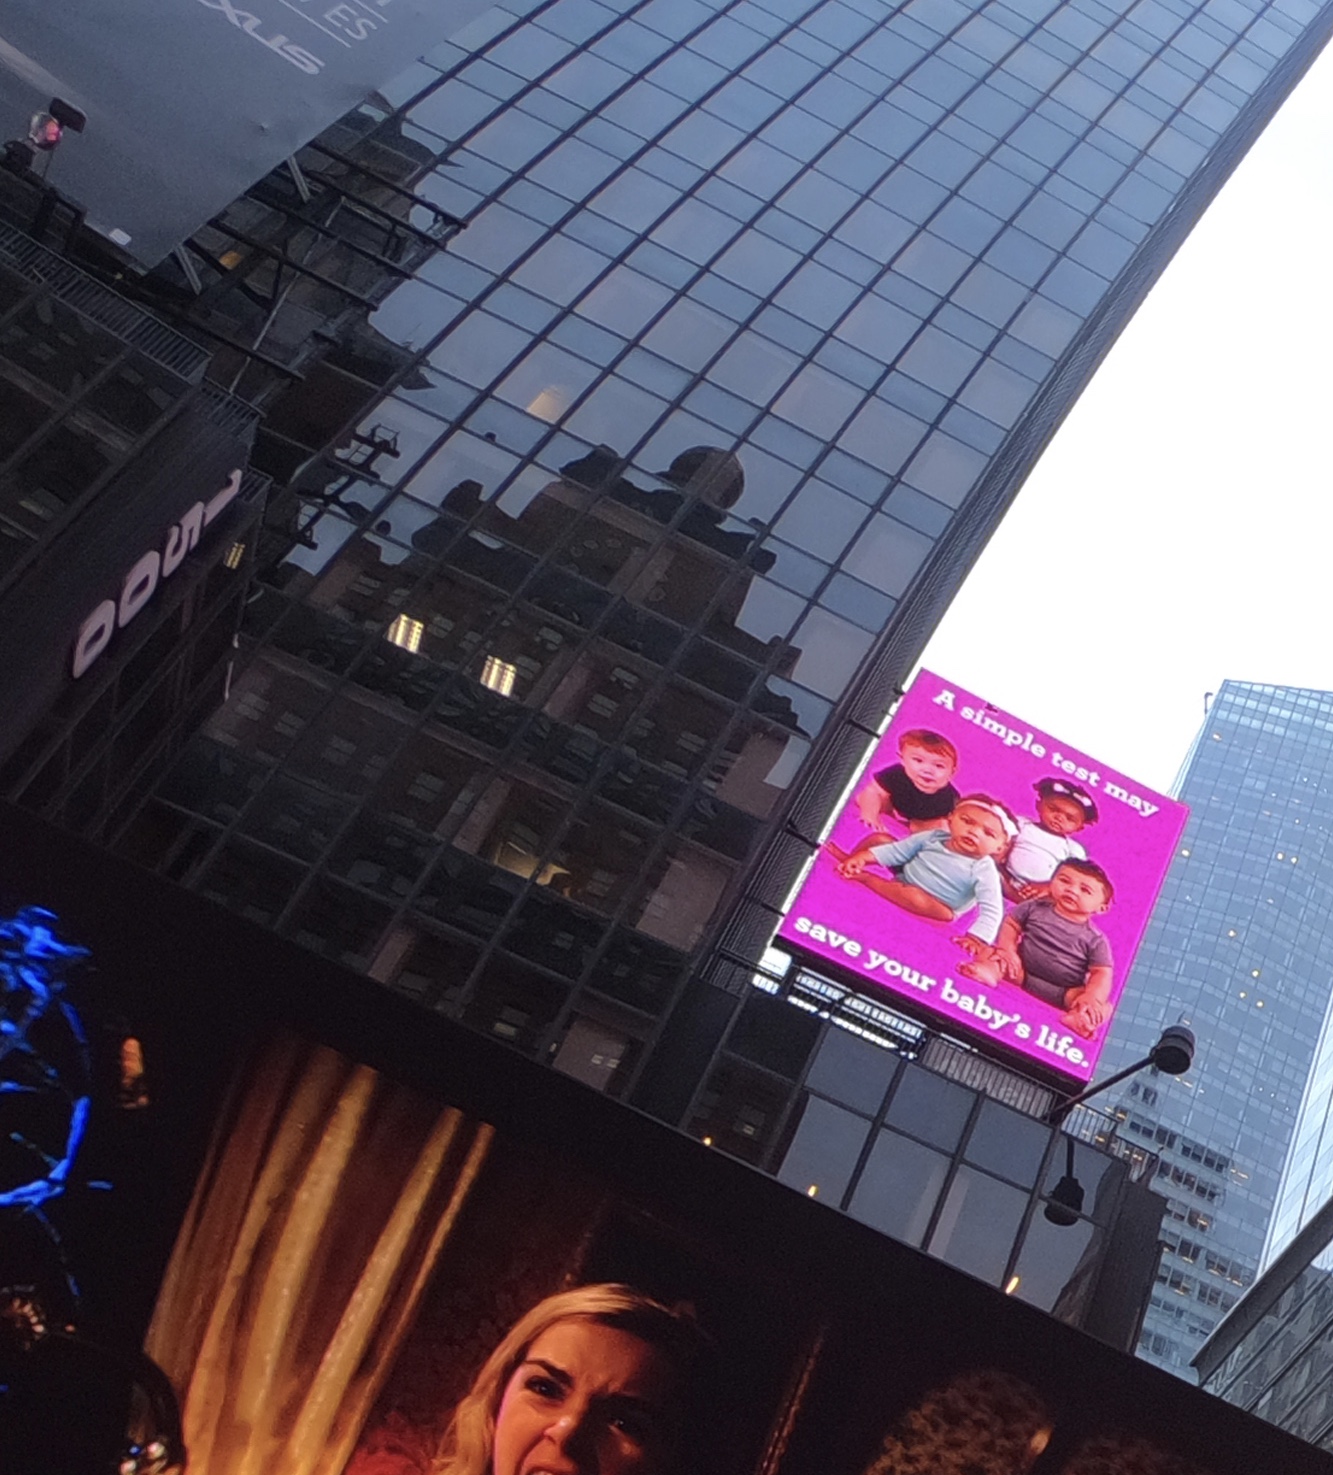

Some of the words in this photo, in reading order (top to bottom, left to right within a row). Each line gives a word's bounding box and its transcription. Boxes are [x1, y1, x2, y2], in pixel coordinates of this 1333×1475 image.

[194, 0, 326, 76] XUS
[932, 688, 957, 711] A
[960, 702, 1047, 758] simple
[1050, 746, 1102, 790] test
[1103, 776, 1160, 819] may
[793, 914, 861, 962] save
[865, 943, 937, 994] your
[939, 976, 1032, 1043] baby's
[1033, 1026, 1091, 1070] life.
